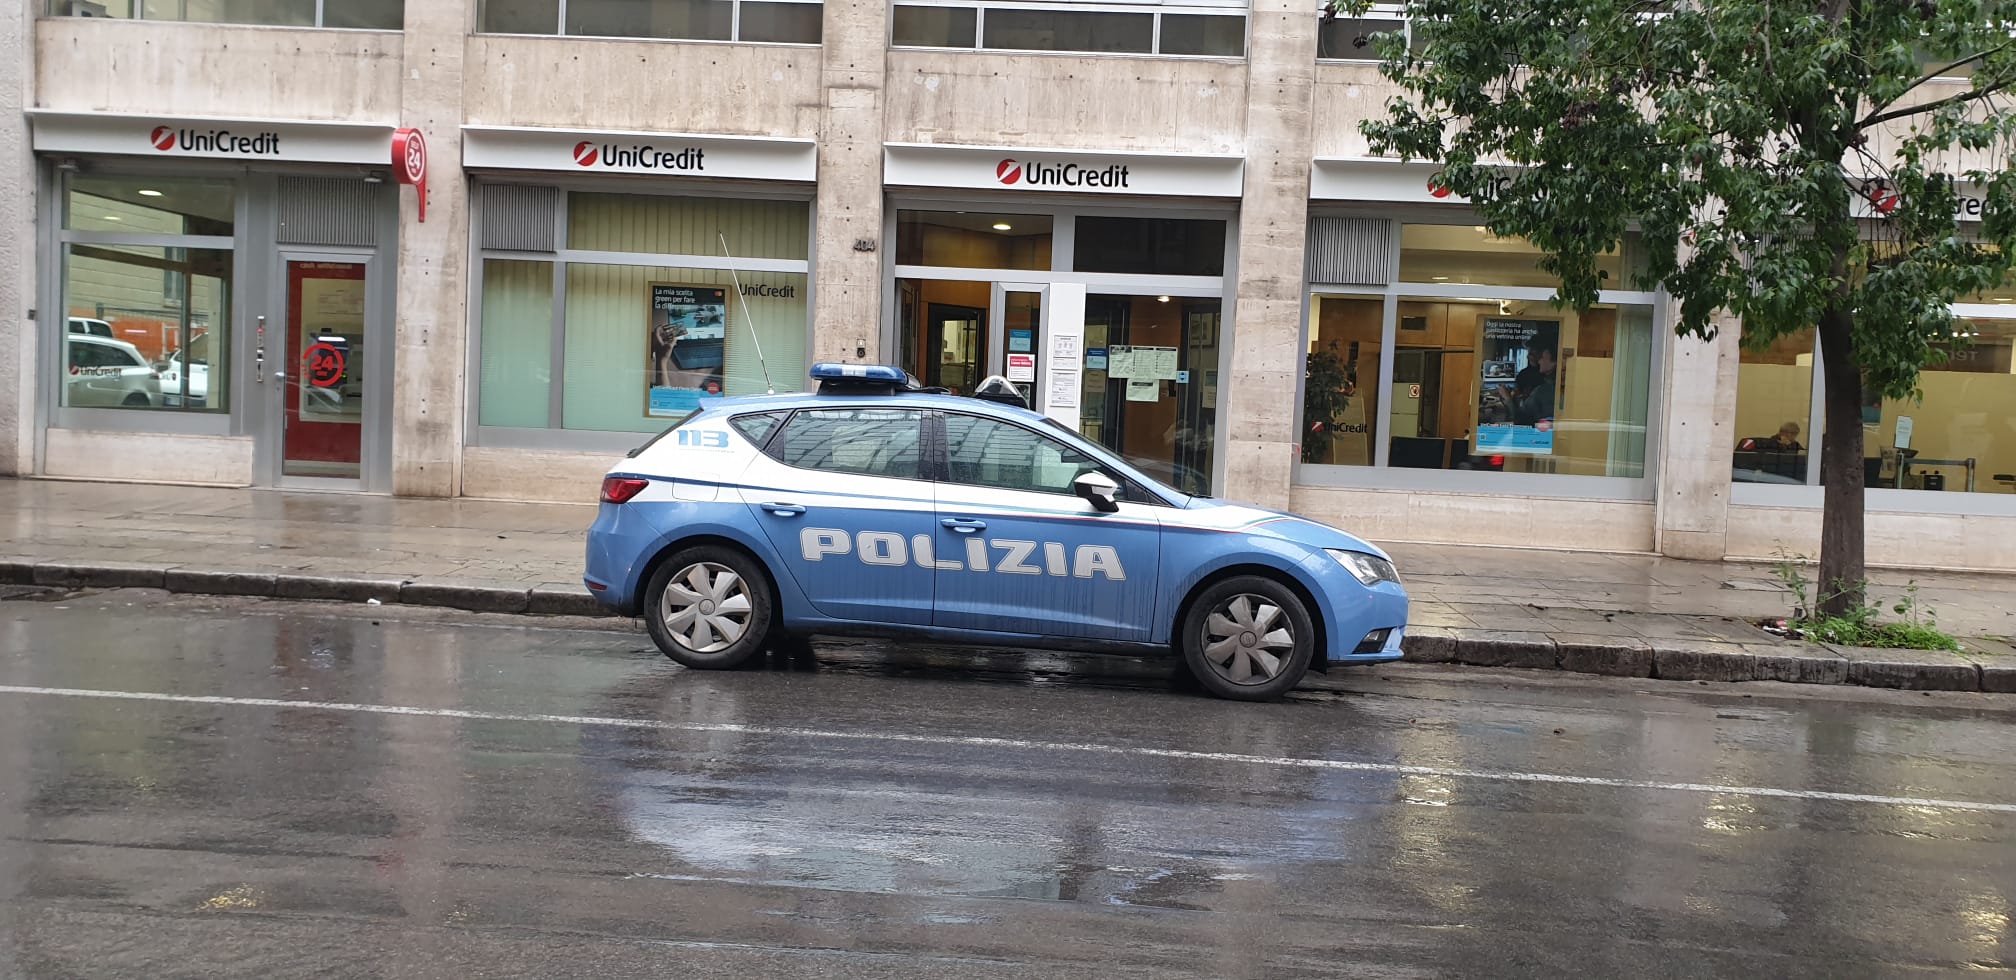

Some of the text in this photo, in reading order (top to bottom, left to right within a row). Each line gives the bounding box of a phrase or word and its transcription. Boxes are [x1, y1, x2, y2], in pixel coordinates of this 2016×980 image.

[180, 129, 280, 155] UniCredit
[408, 147, 421, 170] 24
[602, 144, 705, 171] UniCredit
[1026, 162, 1129, 188] UniCredit
[739, 283, 795, 298] UniCredit
[310, 354, 334, 370] 24
[677, 429, 729, 448] 113
[800, 526, 1127, 581] POLIZIA
